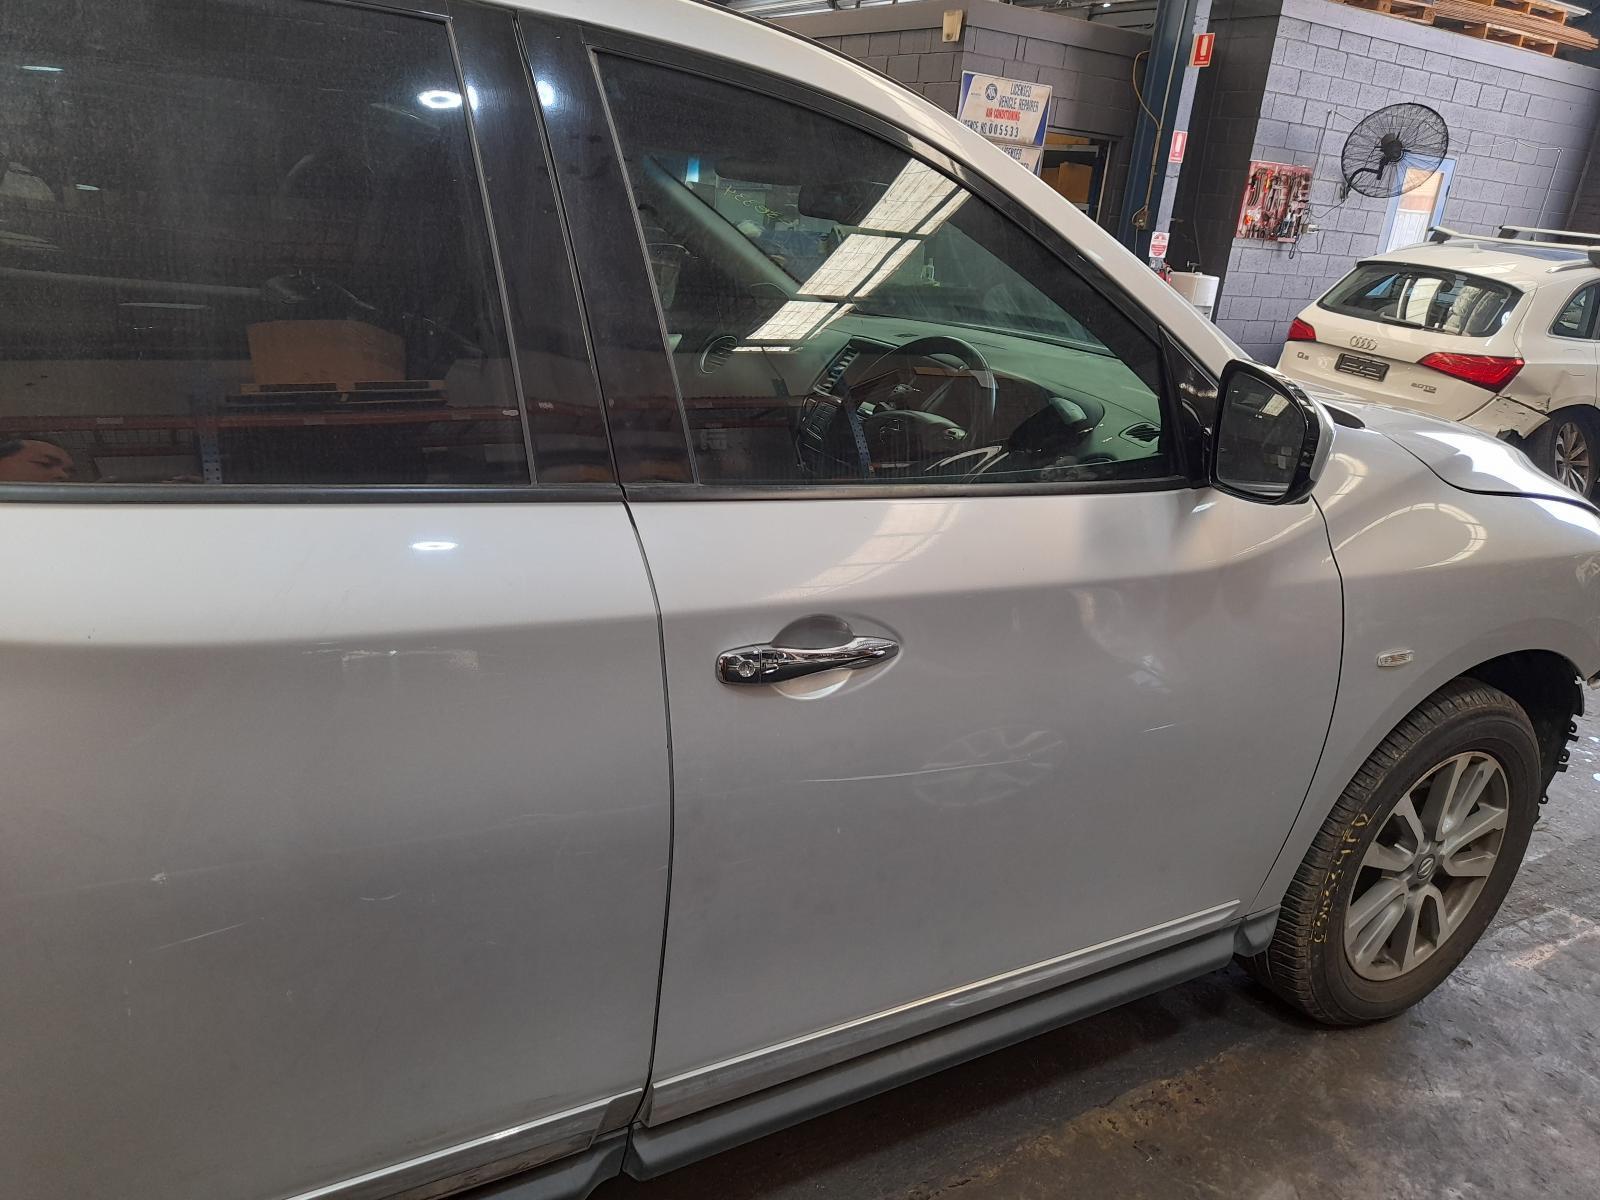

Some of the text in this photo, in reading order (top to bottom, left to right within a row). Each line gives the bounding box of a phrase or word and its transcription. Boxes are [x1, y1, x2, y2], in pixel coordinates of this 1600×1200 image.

[1010, 83, 1032, 97] LICENSED
[999, 95, 1039, 112] VEHICLE REPAIRER
[985, 107, 1021, 121] AIR CONDITIONING
[988, 123, 1019, 138] 005533
